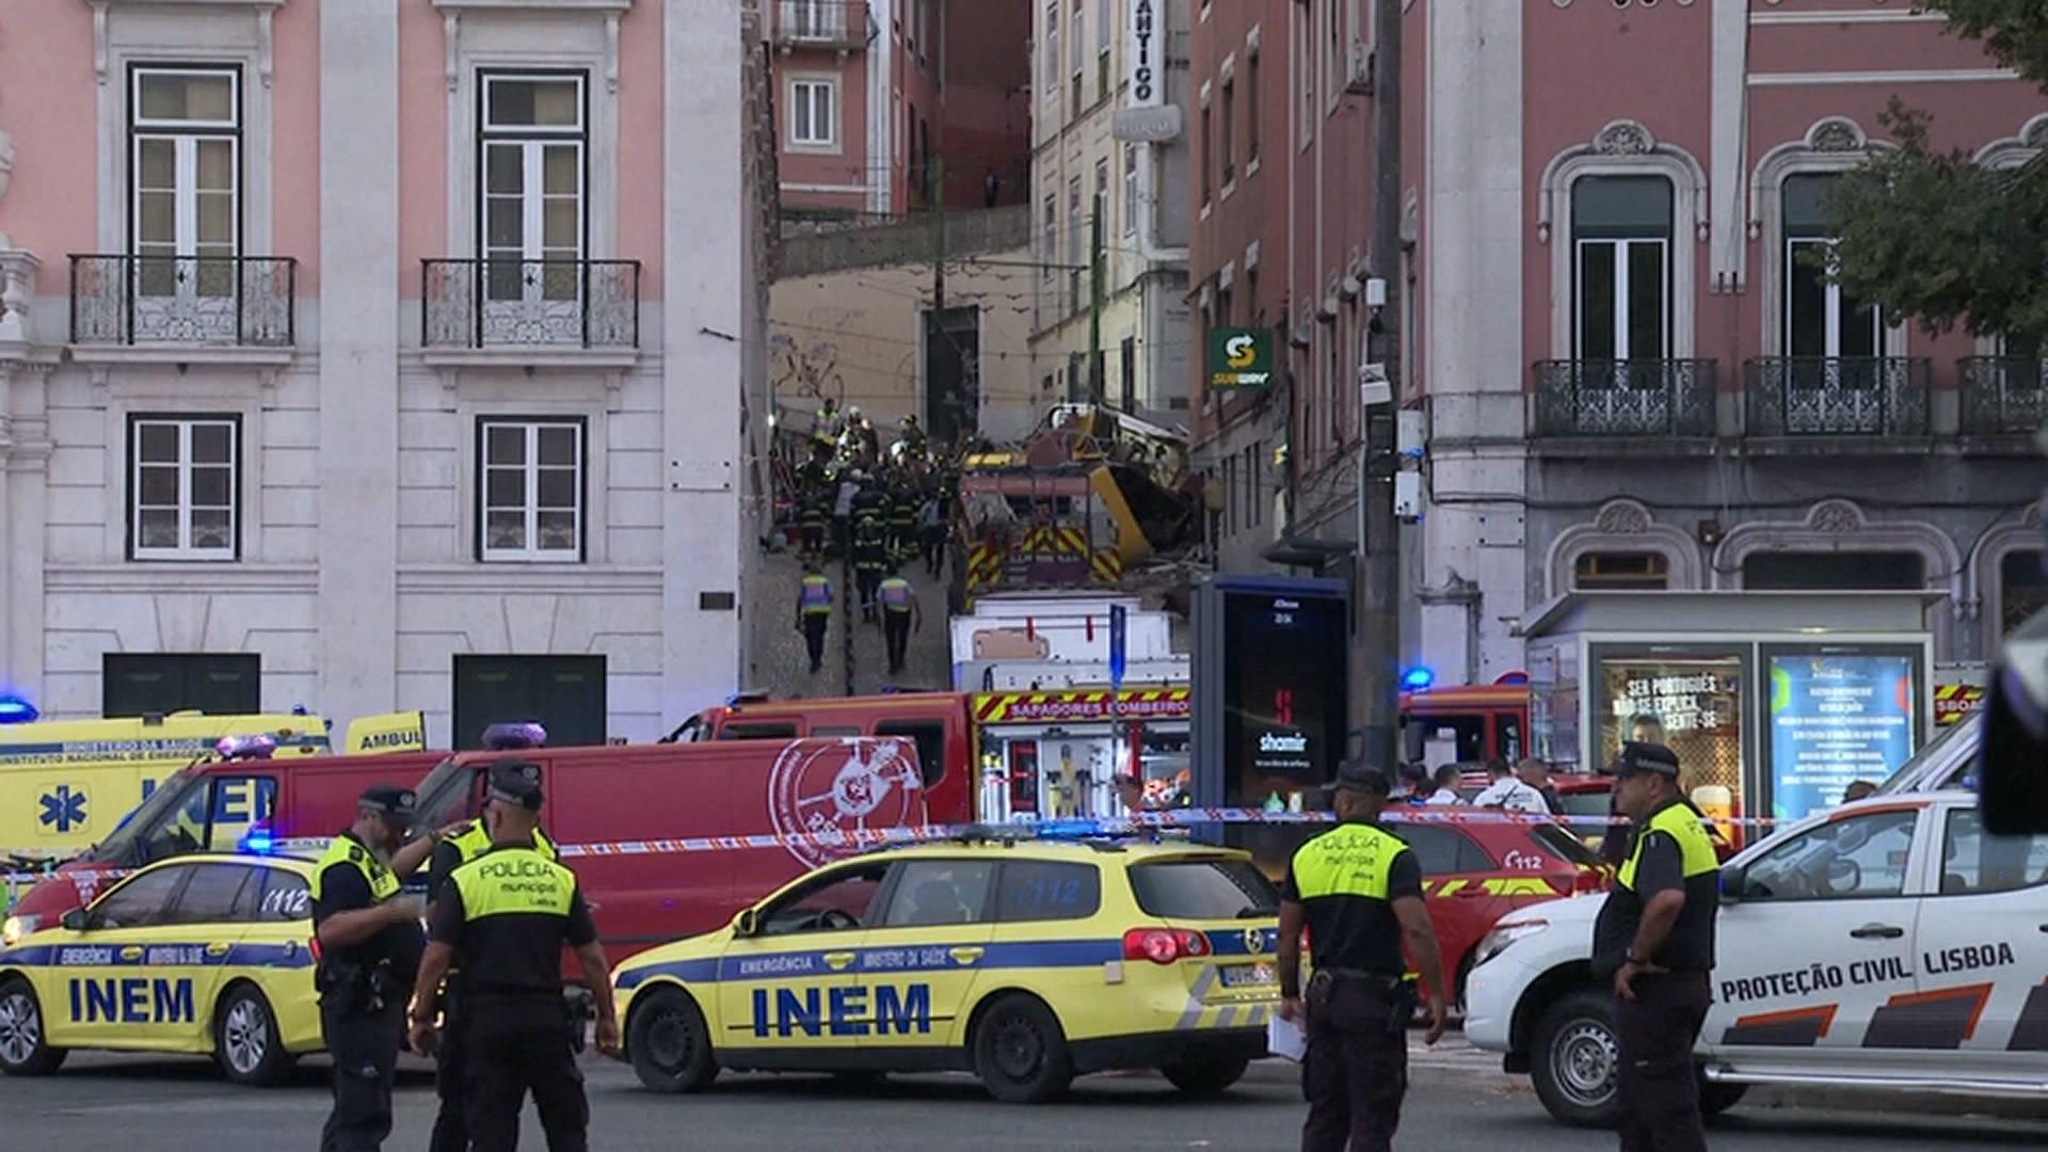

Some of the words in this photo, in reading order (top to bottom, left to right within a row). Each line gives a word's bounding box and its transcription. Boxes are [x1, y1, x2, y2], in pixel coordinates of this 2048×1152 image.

[1213, 372, 1269, 385] SUBWAY
[1010, 702, 1101, 716] SAPADORES
[480, 860, 556, 879] POLÍCIA
[1516, 856, 1542, 869] 112
[740, 955, 812, 974] EMERGÊNCIA
[1721, 963, 1843, 1004] PROTEÇÃO
[1849, 956, 1912, 986] CIVIL
[1924, 942, 2015, 975] LISBOA
[69, 978, 196, 1023] INEM
[752, 984, 931, 1038] INEM
